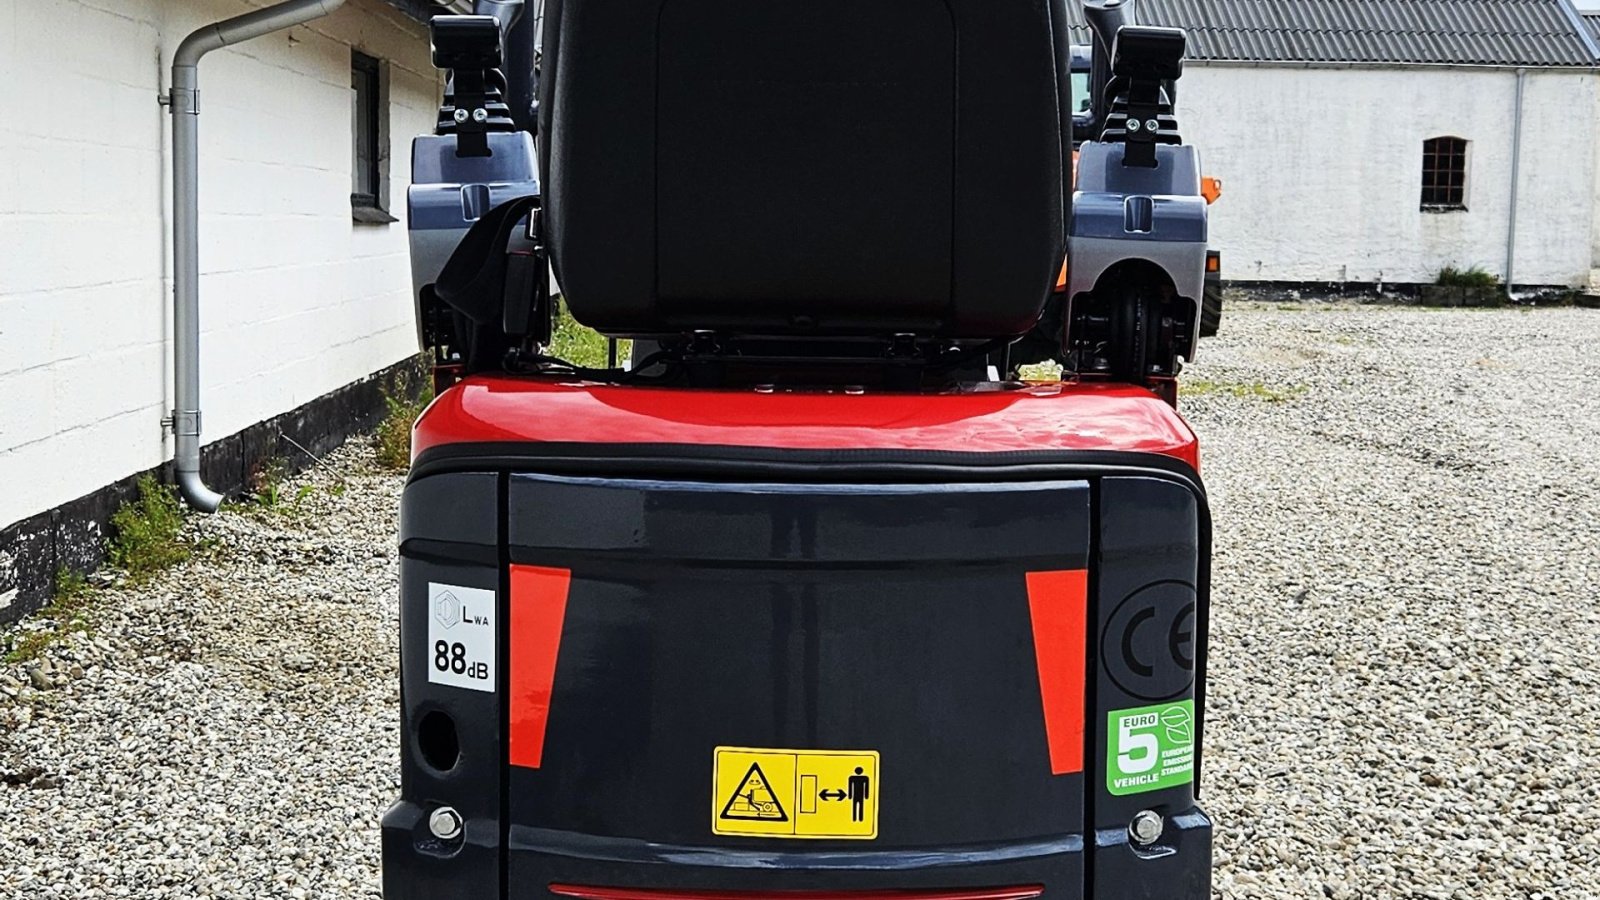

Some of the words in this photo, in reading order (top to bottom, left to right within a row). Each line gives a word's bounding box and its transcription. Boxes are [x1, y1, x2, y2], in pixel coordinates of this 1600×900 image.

[1123, 715, 1155, 728] EURO
[1117, 726, 1158, 774] 5
[1161, 744, 1193, 759] EUROPEA
[1161, 763, 1193, 777] STANDAR
[1113, 773, 1159, 789] VEHICLE
